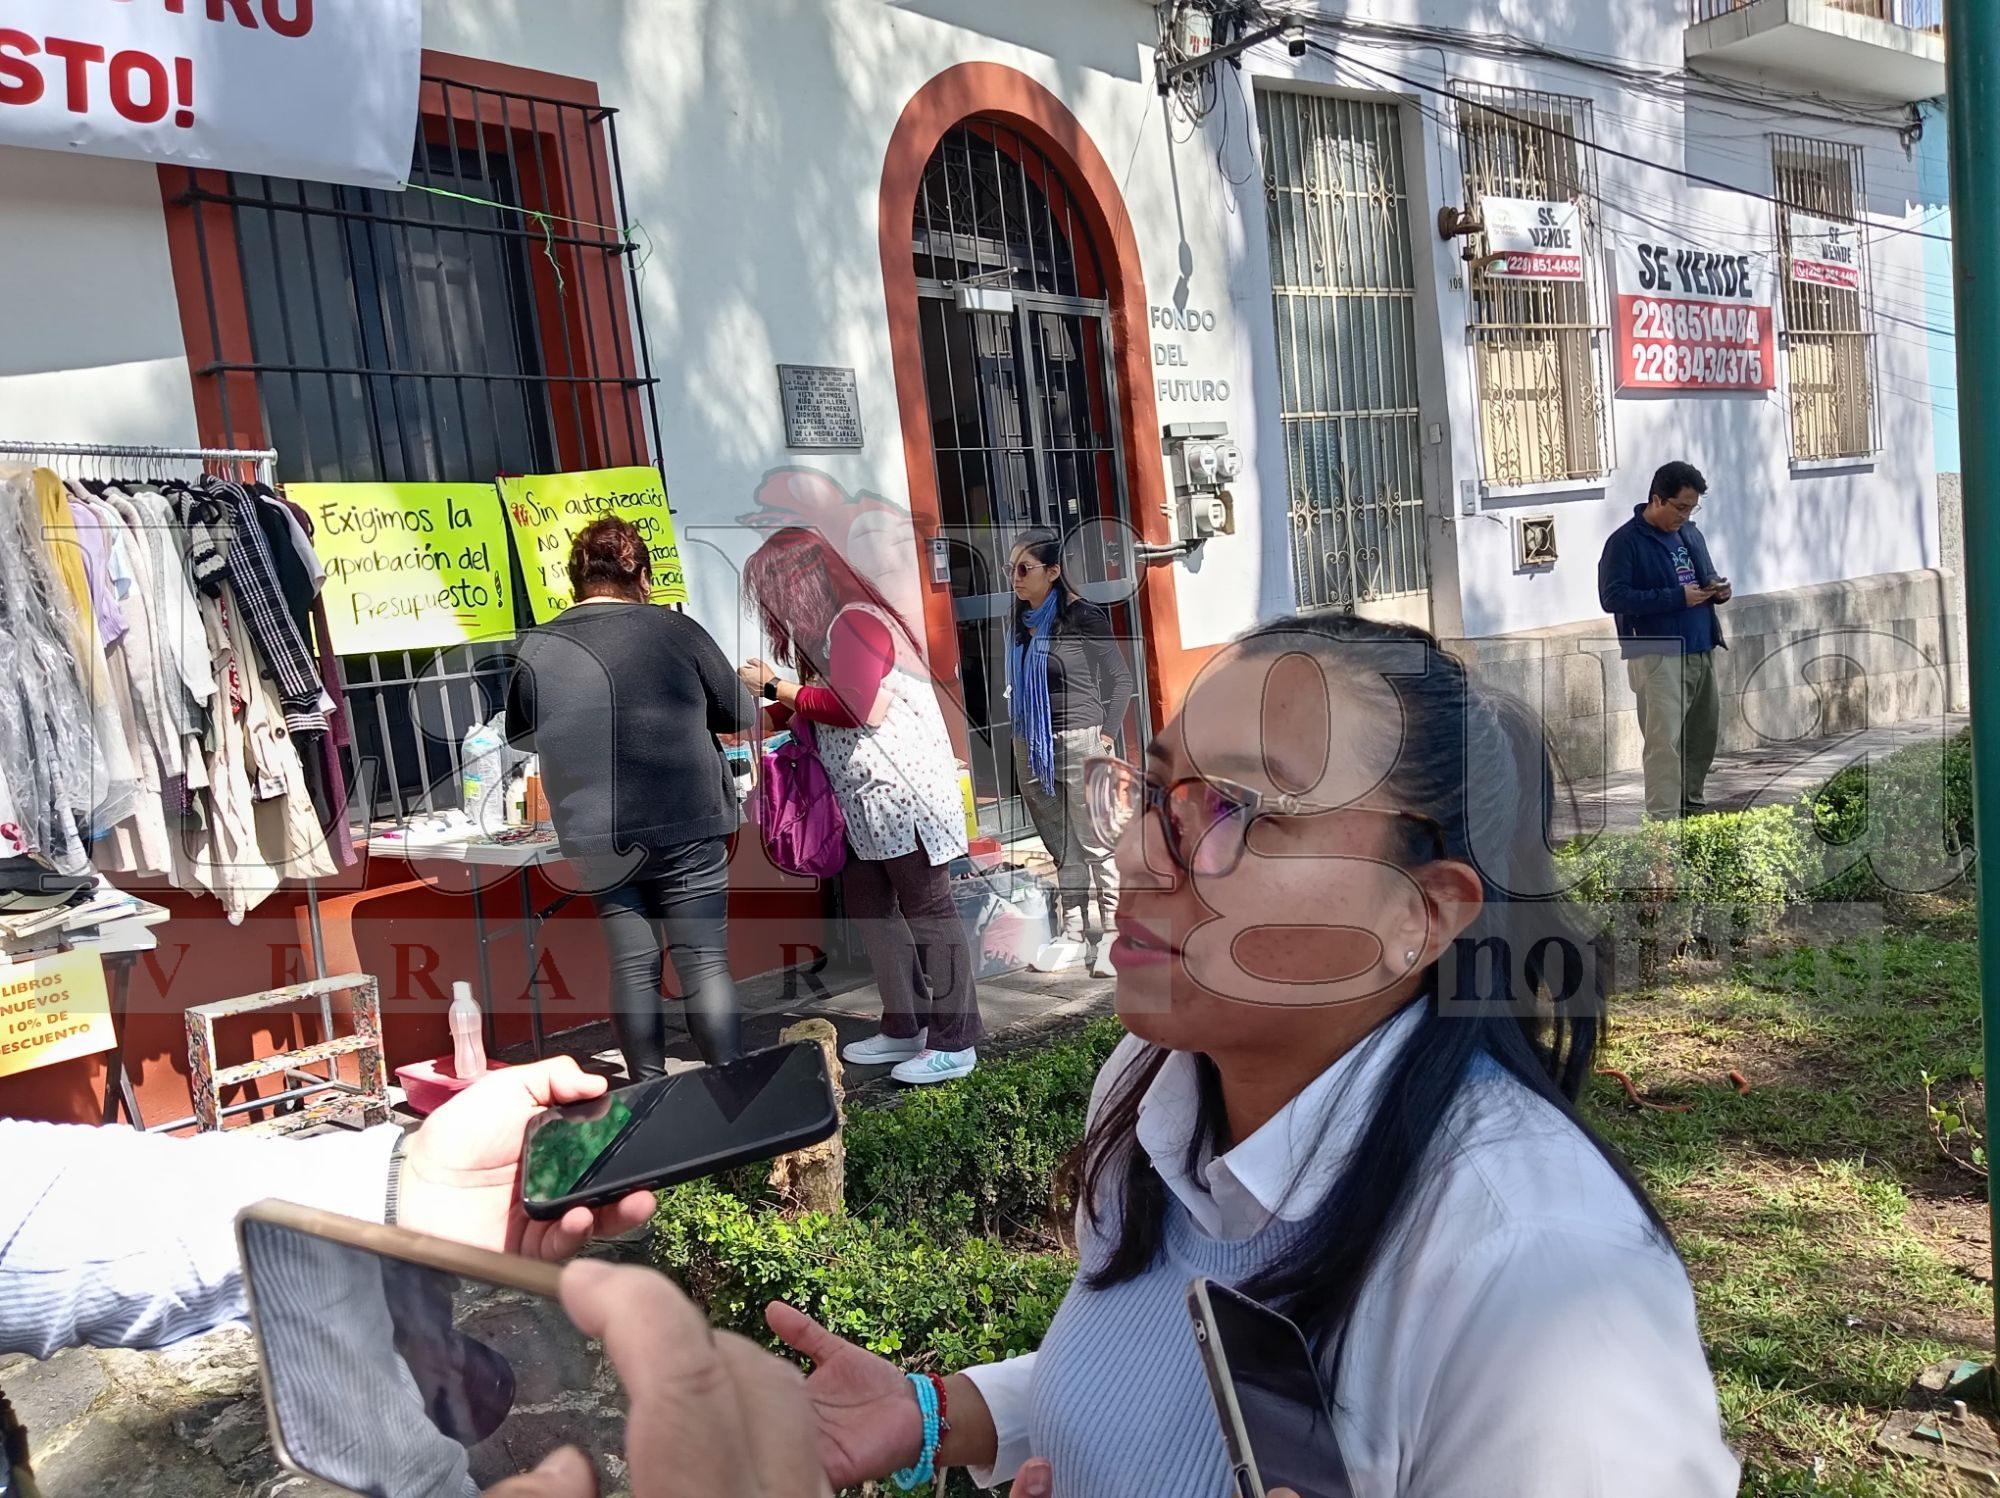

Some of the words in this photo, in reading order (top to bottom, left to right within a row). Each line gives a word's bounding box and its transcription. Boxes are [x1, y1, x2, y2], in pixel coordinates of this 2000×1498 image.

[1538, 207, 1557, 226] SE
[1528, 228, 1572, 249] VENDE
[1829, 227, 1839, 244] SE
[1821, 244, 1851, 264] VENDE
[1638, 244, 1671, 291] SE
[1676, 249, 1752, 298] VENDE
[1150, 306, 1216, 331] FONDO
[1632, 300, 1760, 344] 2288514484
[1154, 343, 1188, 366] DEL
[1632, 344, 1762, 384] 2283430375
[1158, 379, 1231, 402] FUTURO
[320, 502, 434, 544] Exigimos
[448, 498, 472, 530] la
[325, 545, 451, 585] aprobación
[458, 542, 491, 572] del
[2, 974, 62, 997] LIBROS
[0, 990, 70, 1016] NUEVOS
[9, 1017, 42, 1034] 10%
[46, 1011, 69, 1025] DE
[0, 1023, 91, 1055] ESCUENTO
